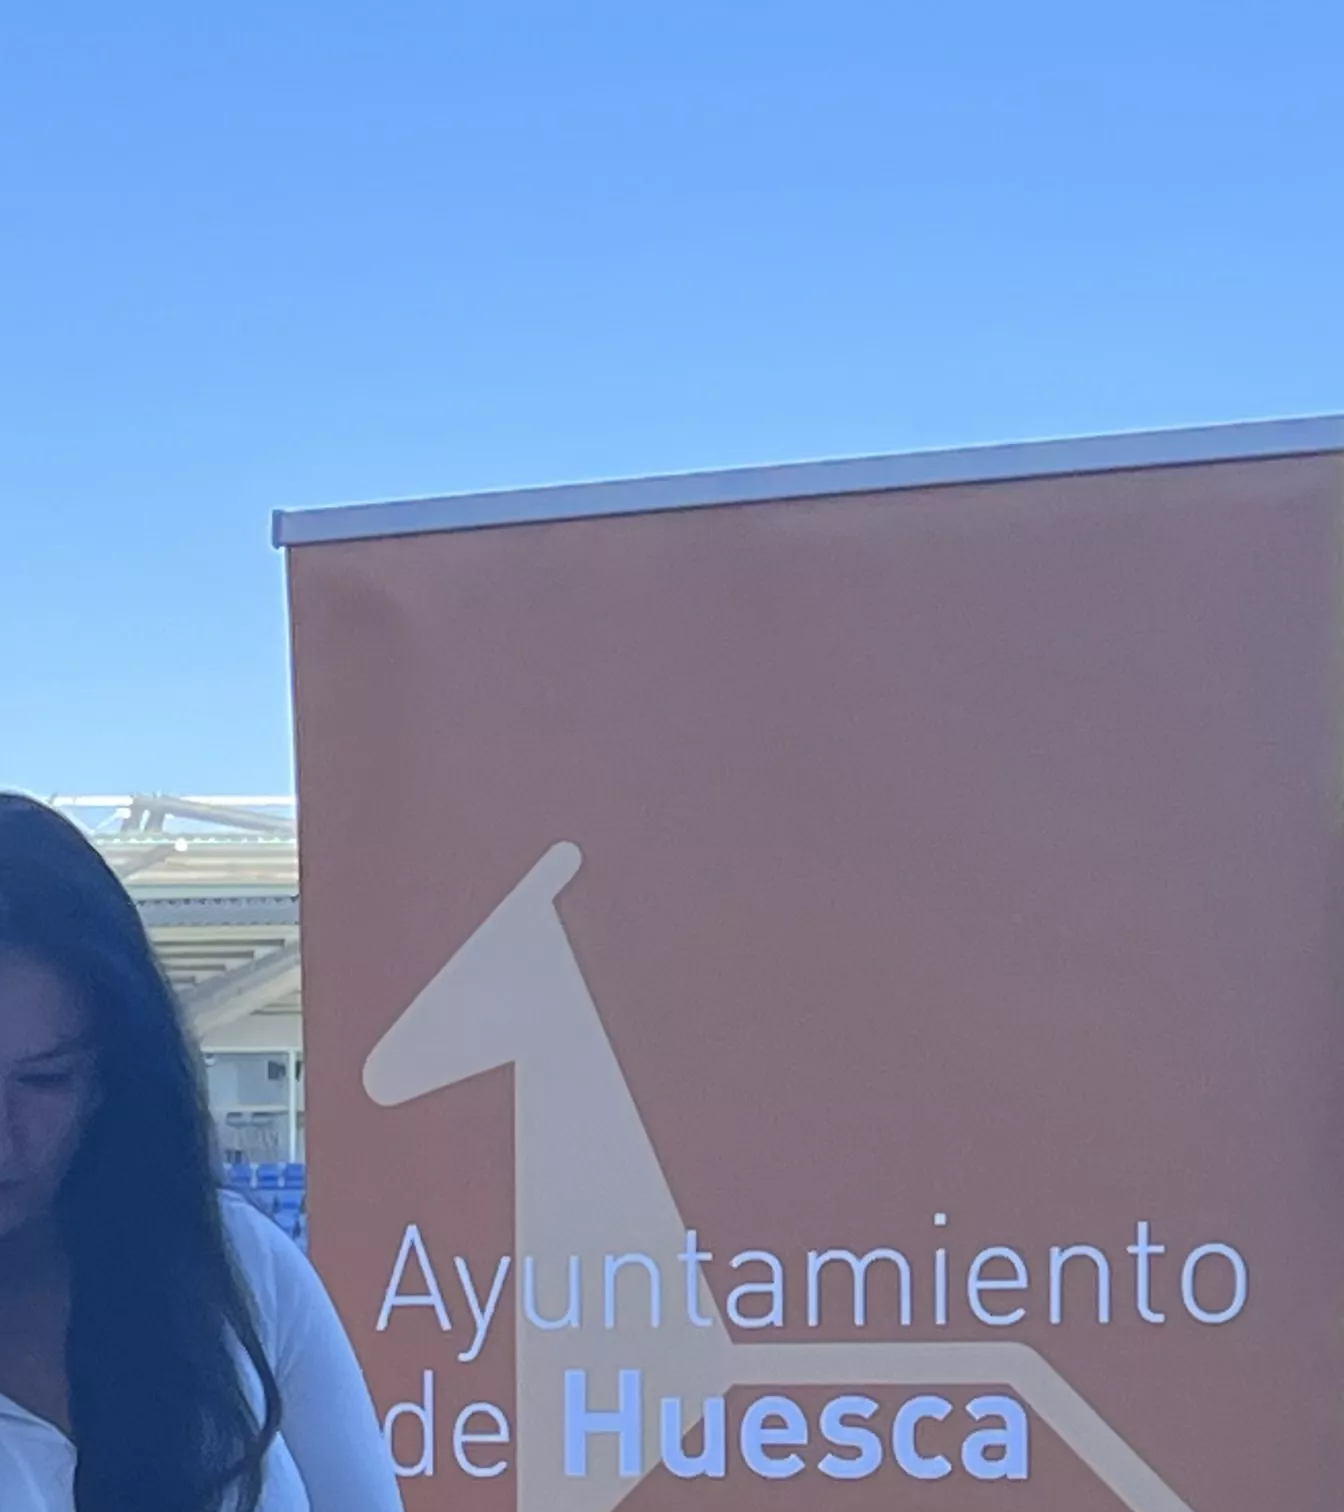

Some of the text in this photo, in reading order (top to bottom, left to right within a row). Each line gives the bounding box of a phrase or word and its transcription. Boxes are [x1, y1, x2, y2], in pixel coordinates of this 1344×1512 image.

[376, 1213, 1248, 1364] Ayuntamiento
[383, 1369, 1030, 1481] de Huesca
